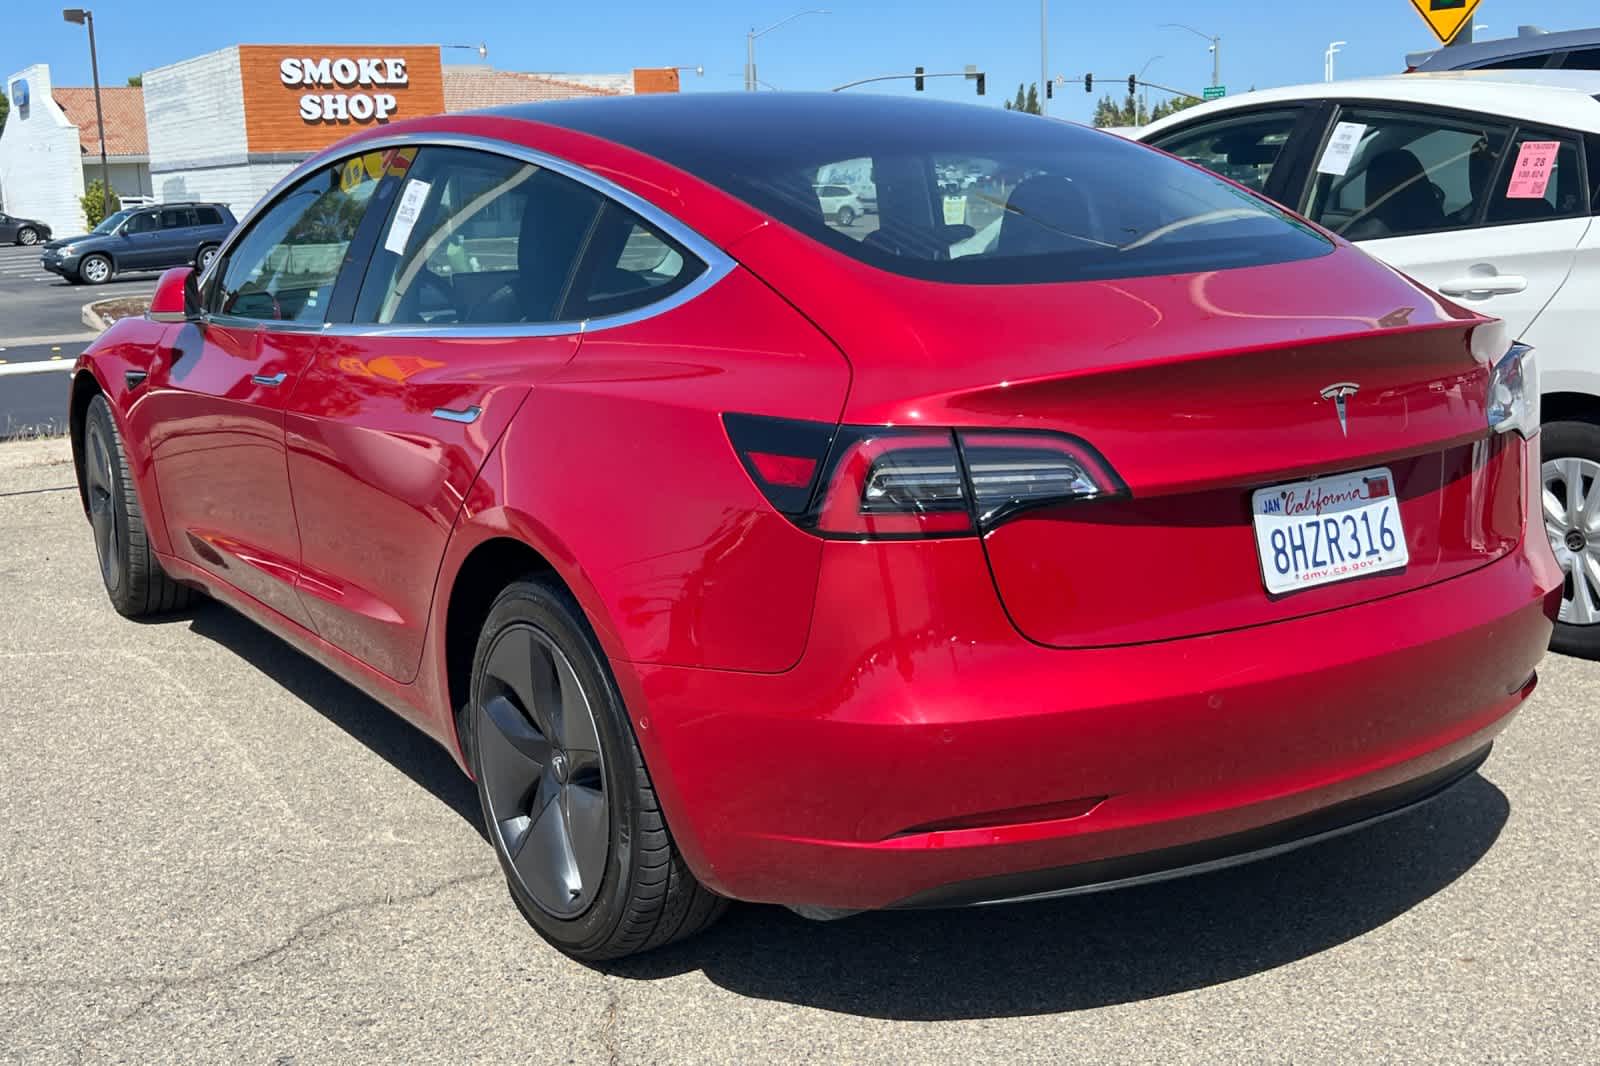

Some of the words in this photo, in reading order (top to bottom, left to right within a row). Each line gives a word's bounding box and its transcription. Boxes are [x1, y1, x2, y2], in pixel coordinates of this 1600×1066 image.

[280, 58, 408, 87] SMOKE
[299, 93, 397, 122] SHOP
[1263, 497, 1280, 513] JAN
[1285, 488, 1368, 516] California
[1271, 506, 1396, 574] 8HZR316
[1302, 560, 1374, 581] dmv.ca.gov
